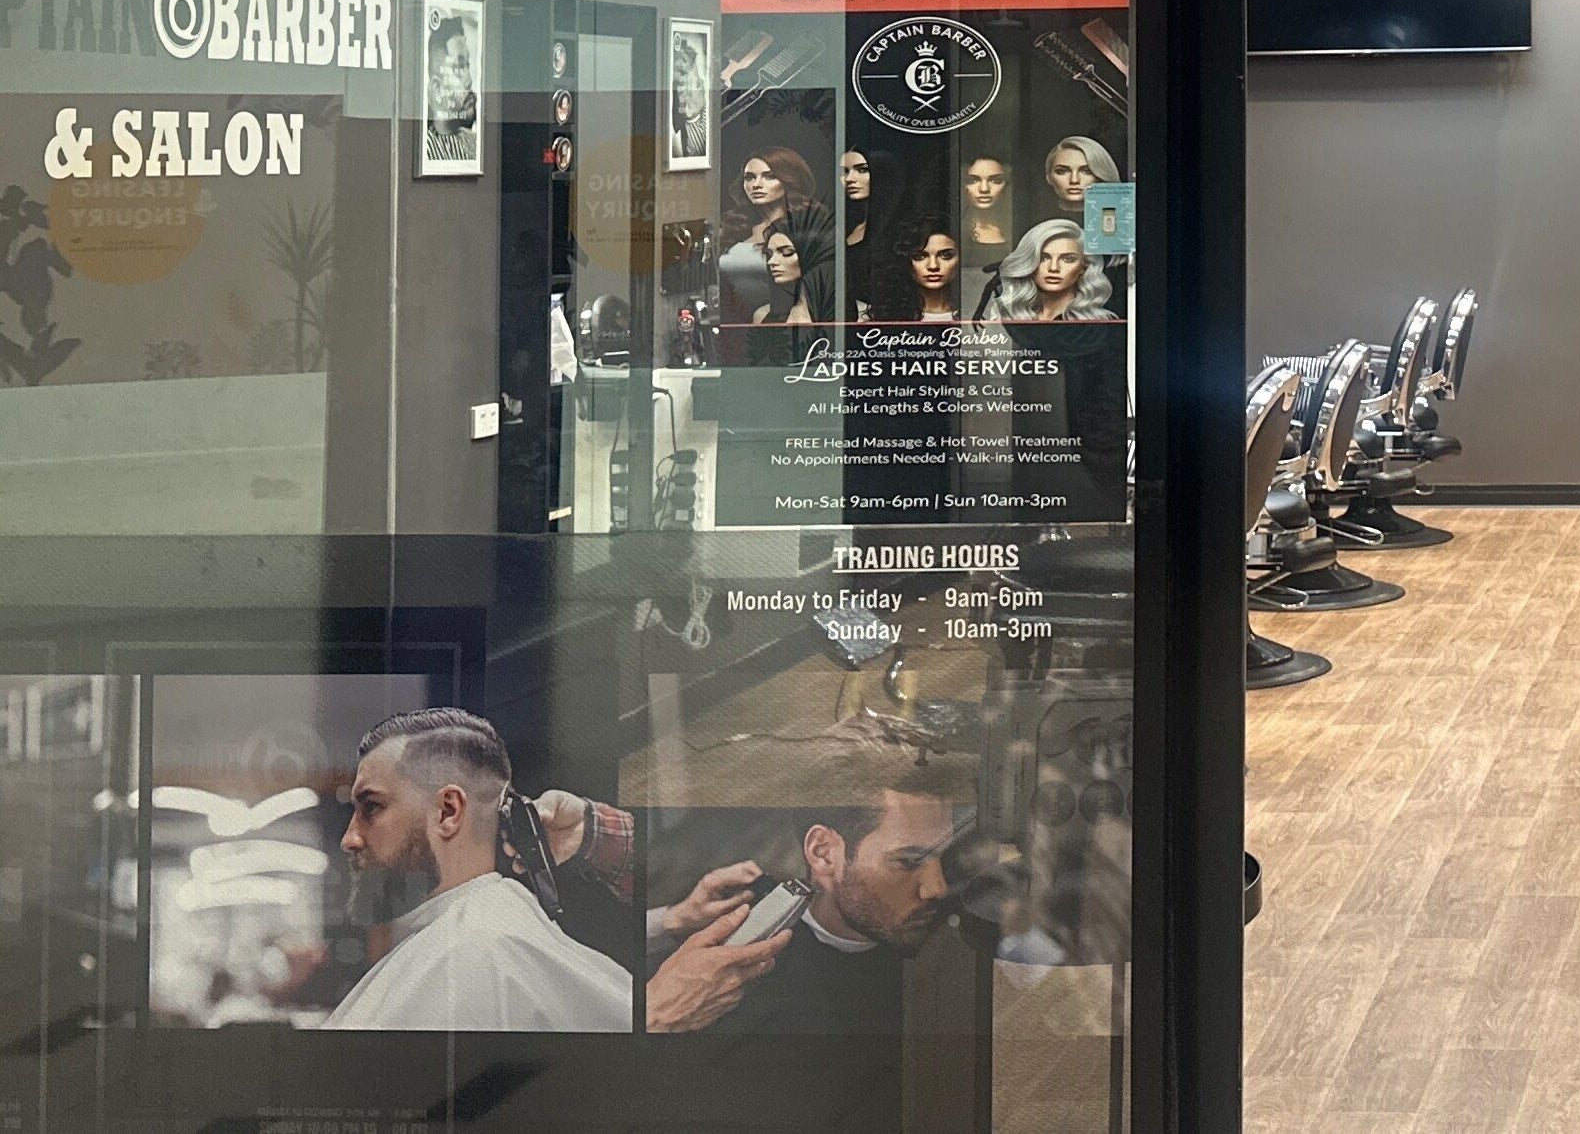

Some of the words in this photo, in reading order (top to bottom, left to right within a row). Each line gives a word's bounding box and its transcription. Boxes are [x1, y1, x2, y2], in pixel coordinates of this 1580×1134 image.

[866, 24, 924, 63] CAPTAIN
[931, 24, 987, 61] BARBER
[877, 103, 910, 124] QUALITY
[911, 118, 937, 127] OVER
[45, 108, 93, 179] &
[112, 110, 303, 176] SALON
[856, 328, 936, 352] Captain
[939, 327, 1008, 347] Barber
[784, 338, 883, 383] LADIES
[891, 360, 948, 376] HAIR
[954, 358, 1059, 376] SERVICES
[818, 349, 844, 360] Shop
[846, 349, 867, 359] 22A
[868, 349, 896, 359] Oasis
[898, 348, 945, 360] Shopping
[984, 347, 1041, 358] Palmerston
[840, 385, 884, 400] Expert
[887, 385, 916, 398] Hair
[919, 384, 965, 399] Styling
[968, 384, 979, 397] &
[982, 384, 1013, 397] Cuts
[808, 402, 827, 415] All
[830, 402, 861, 414] Hair
[864, 401, 919, 416] Lengths
[922, 401, 934, 413] &
[937, 400, 984, 413] Colors
[986, 400, 1053, 413] Welcome
[785, 437, 820, 449] FREE
[824, 437, 859, 449] Head
[863, 437, 923, 450] Massage
[926, 436, 937, 448] &
[941, 436, 966, 447] Hot
[970, 435, 1009, 447] Towel
[1012, 435, 1082, 447] Treatment
[770, 454, 791, 466] No
[794, 452, 890, 467] Appointments
[893, 452, 945, 464] Needed
[956, 451, 1015, 463] Walk-ins
[1017, 451, 1082, 463] Welcome
[775, 495, 846, 509] Mon-Sat
[849, 494, 929, 510] 9am-6pm
[944, 494, 976, 507] Sun
[980, 493, 1067, 509] 10am-3pm
[833, 545, 936, 569] TRADING
[941, 544, 1020, 568] HOURS
[727, 590, 807, 614] Monday
[812, 591, 833, 610] to
[839, 589, 903, 613] Friday
[945, 587, 1044, 610] 9am-6pm
[827, 620, 902, 643] Sunday
[945, 618, 1052, 641] 10am-3pm
